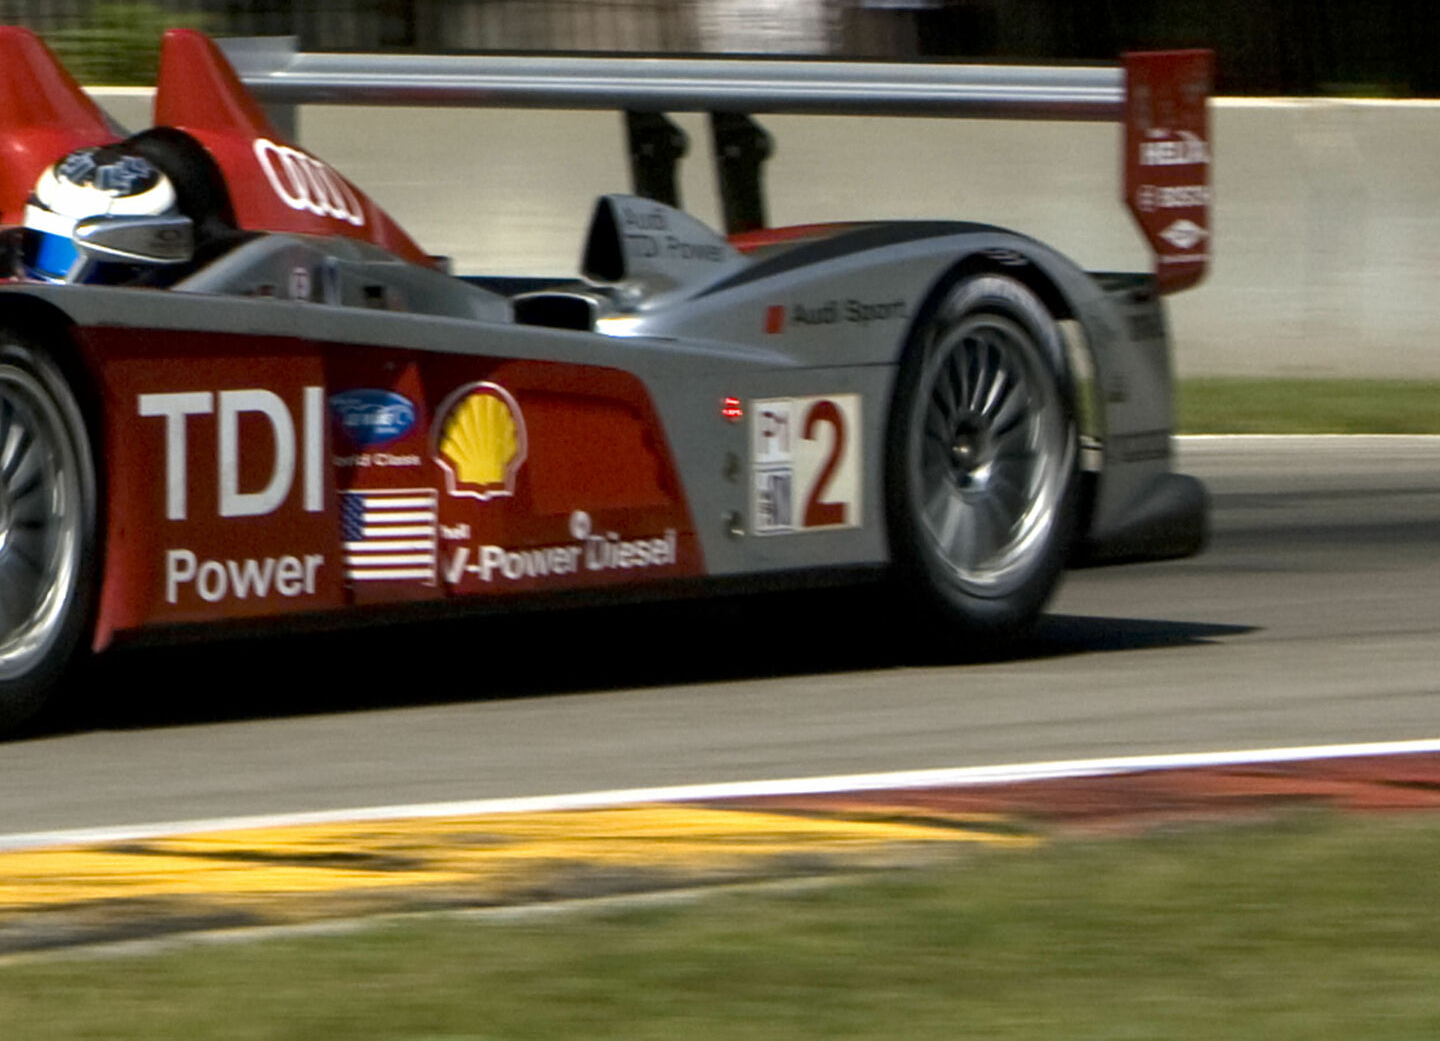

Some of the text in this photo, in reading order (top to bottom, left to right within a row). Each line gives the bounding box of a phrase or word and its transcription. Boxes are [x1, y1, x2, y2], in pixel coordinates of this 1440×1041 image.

[792, 299, 908, 328] Audi Sport
[138, 386, 325, 521] TDI
[801, 400, 849, 527] 2
[166, 548, 325, 604] Power
[584, 528, 677, 571] Diesel
